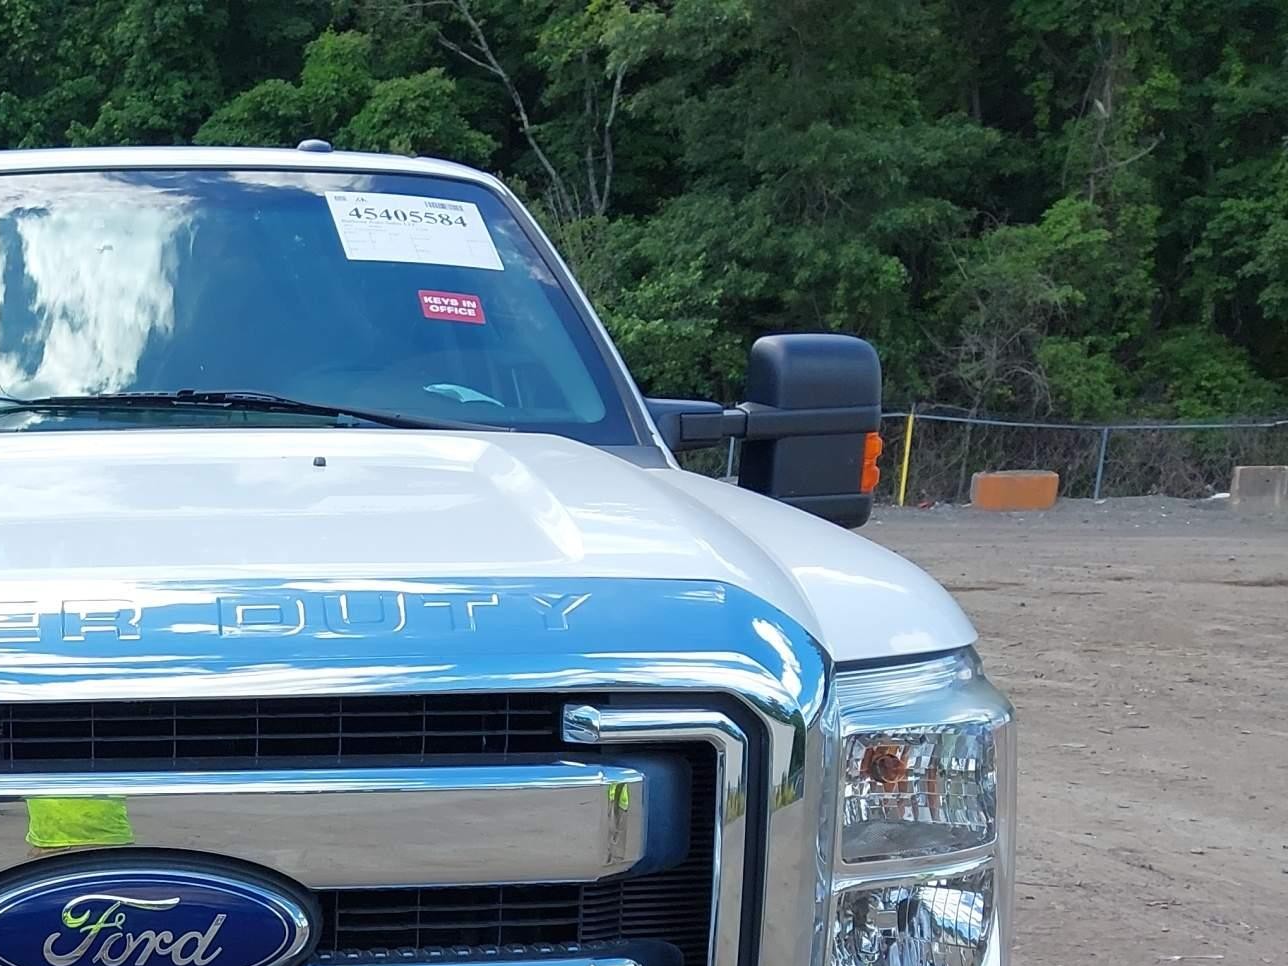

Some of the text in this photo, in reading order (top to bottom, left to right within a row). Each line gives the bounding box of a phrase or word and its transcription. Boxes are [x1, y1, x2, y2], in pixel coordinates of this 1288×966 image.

[348, 207, 467, 227] 45405584
[423, 296, 477, 308] KEYS IN
[429, 305, 477, 317] OFFICE
[215, 593, 593, 639] DUTY
